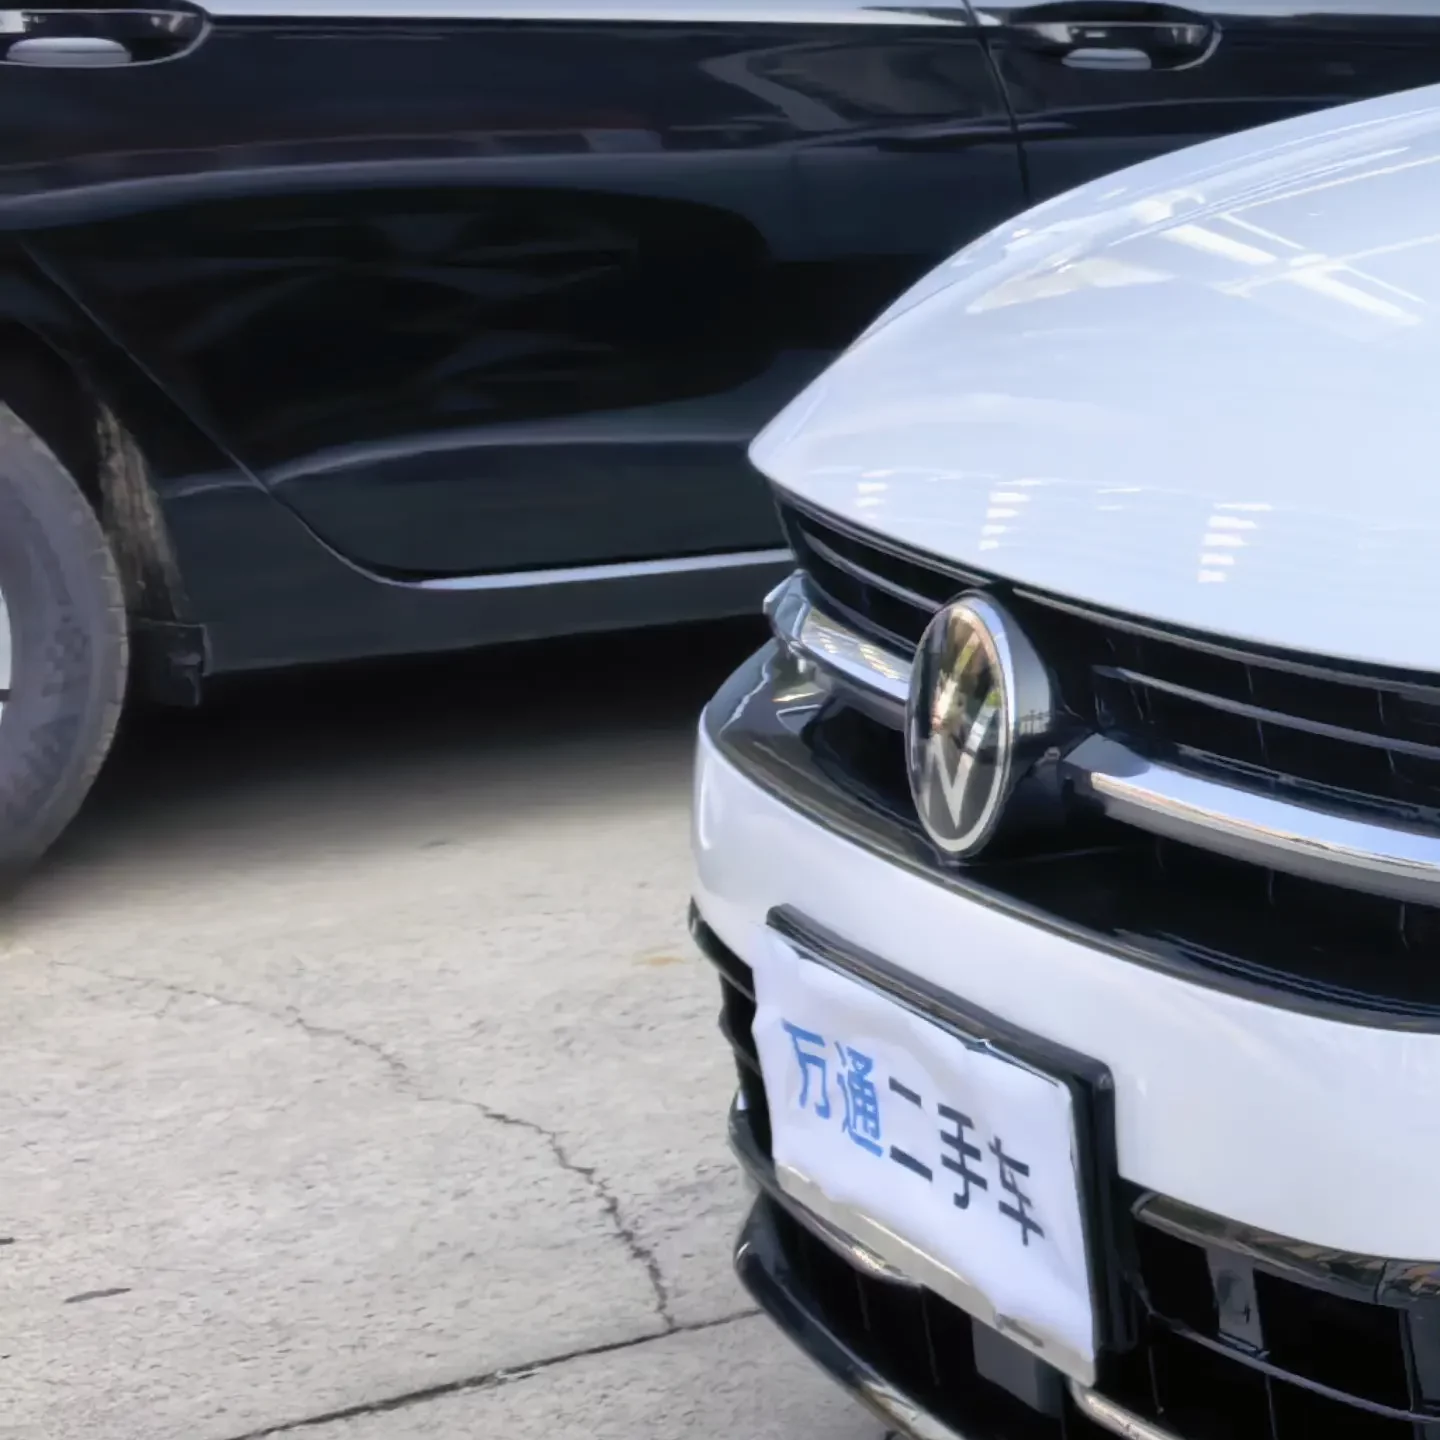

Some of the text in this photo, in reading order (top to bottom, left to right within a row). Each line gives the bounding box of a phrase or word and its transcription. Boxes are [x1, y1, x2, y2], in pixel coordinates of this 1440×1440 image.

[781, 1017, 1046, 1246] 万通二手车
